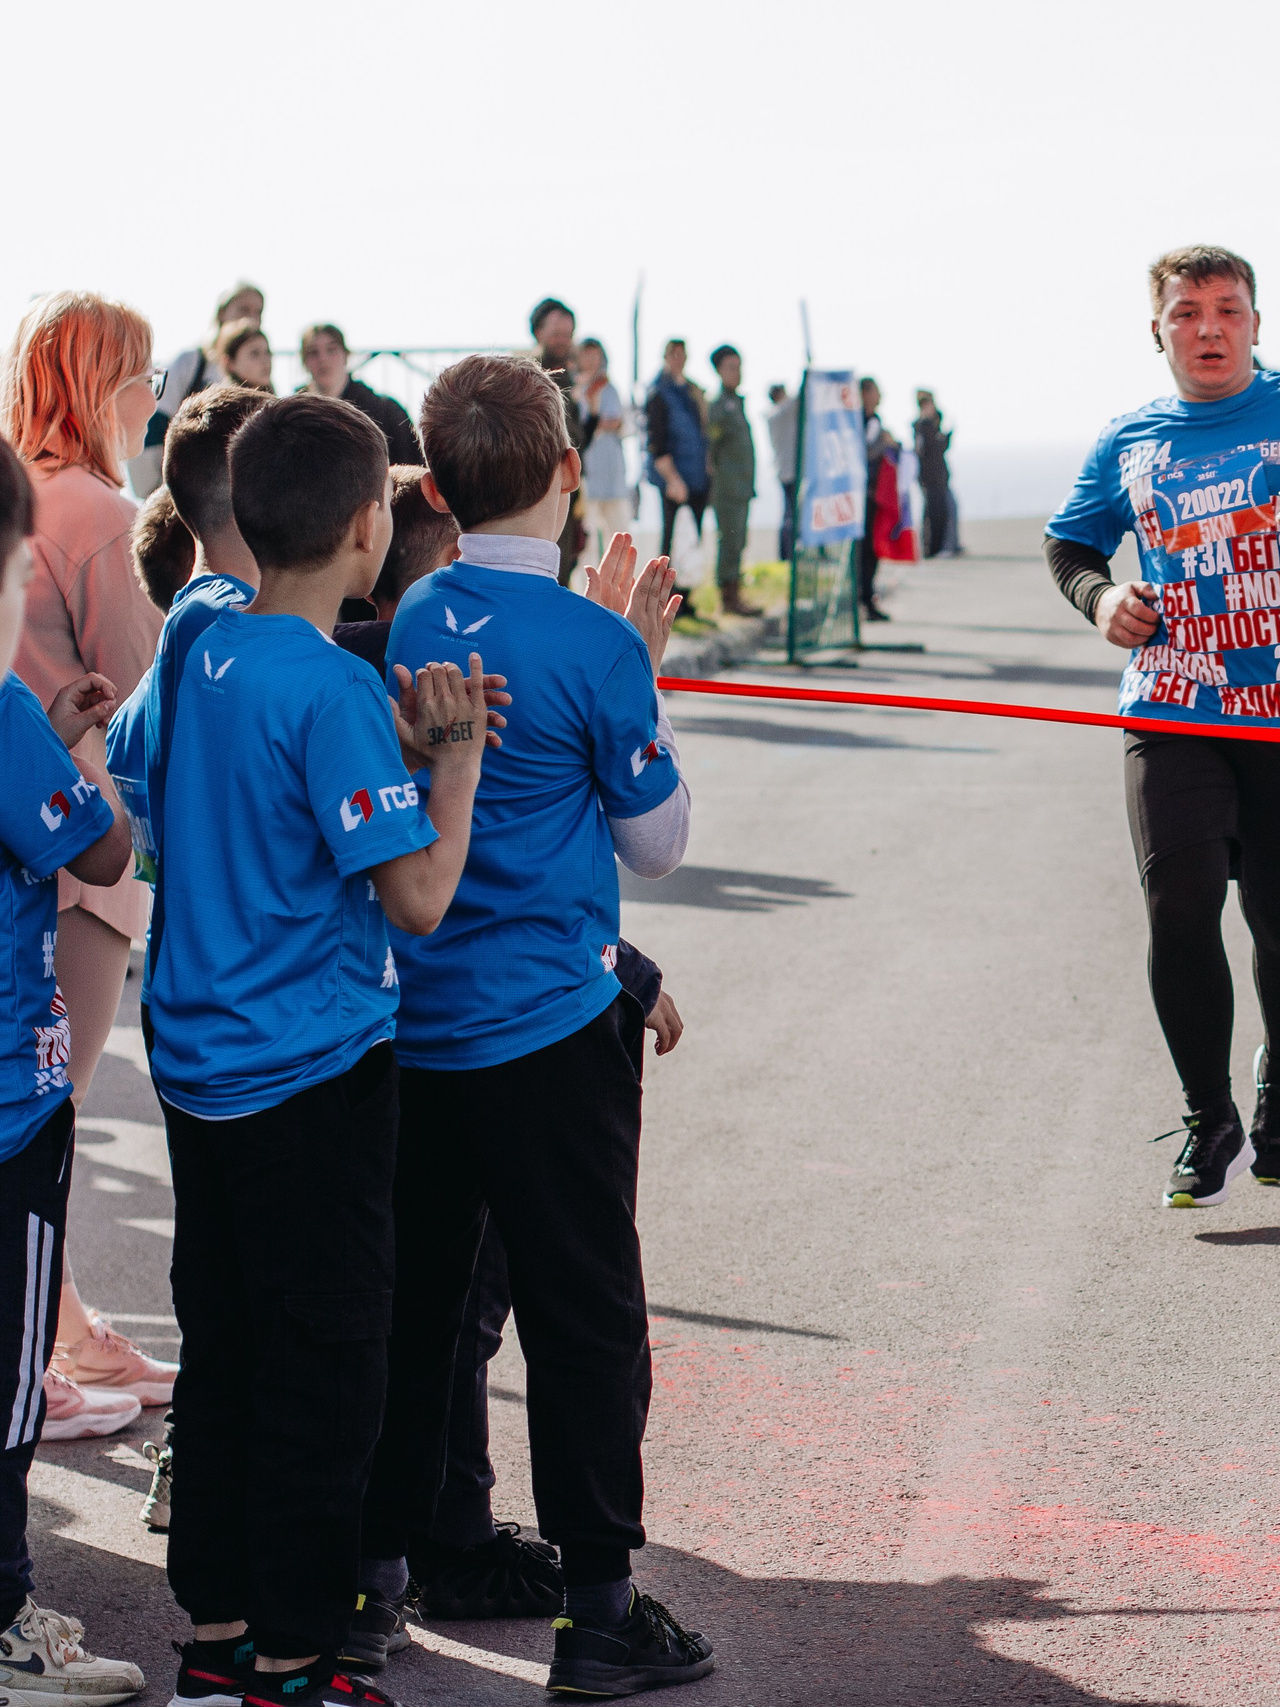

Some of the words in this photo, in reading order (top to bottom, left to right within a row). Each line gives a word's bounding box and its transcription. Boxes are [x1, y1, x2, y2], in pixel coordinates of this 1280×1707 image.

[1118, 440, 1172, 487] 2024
[1177, 479, 1248, 520] 20022
[378, 782, 418, 812] ПСБ
